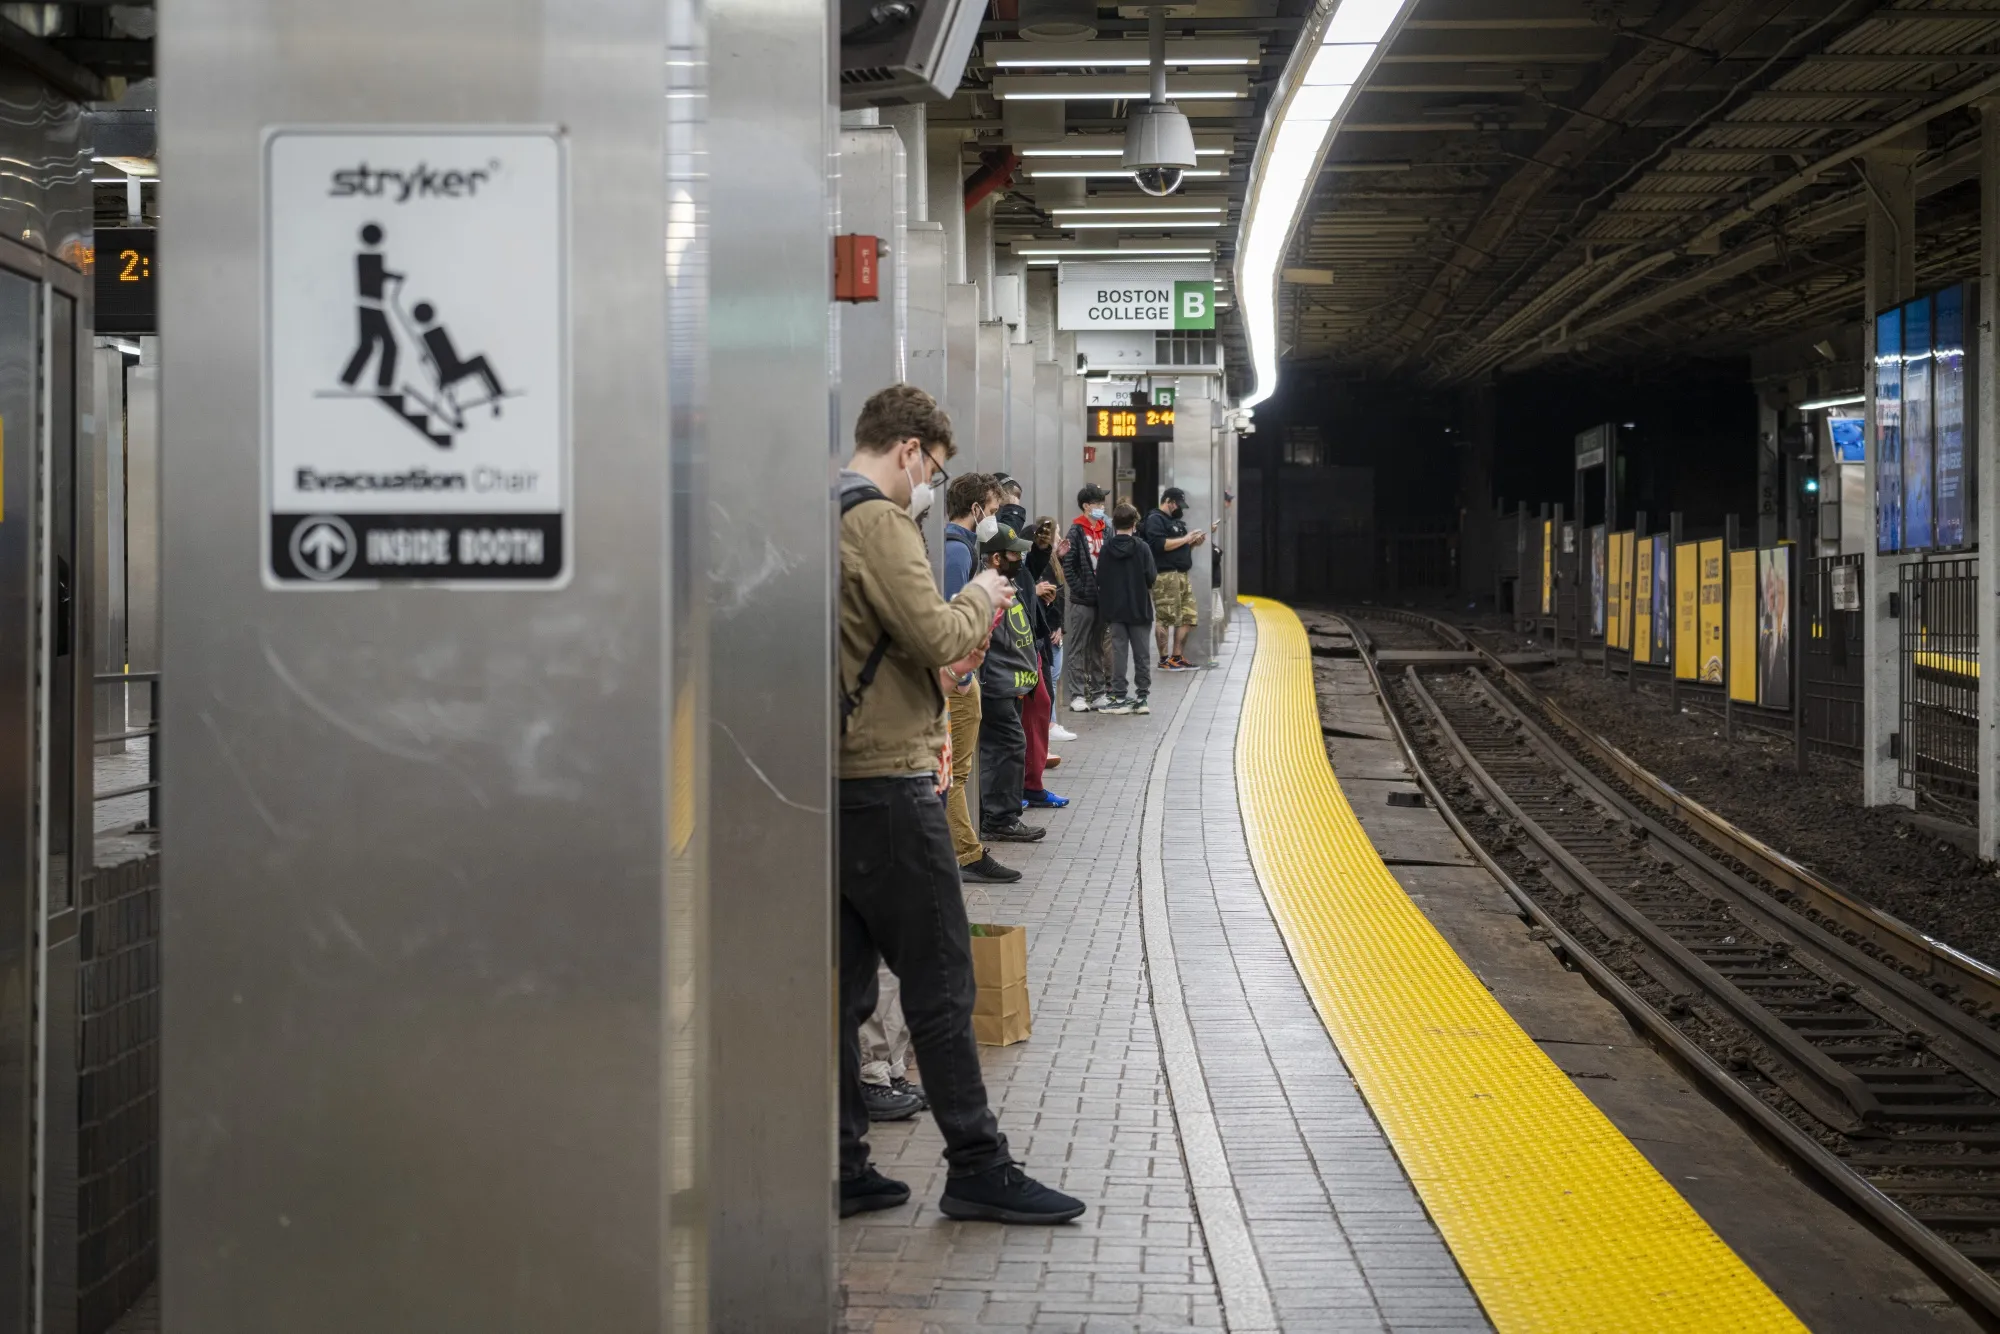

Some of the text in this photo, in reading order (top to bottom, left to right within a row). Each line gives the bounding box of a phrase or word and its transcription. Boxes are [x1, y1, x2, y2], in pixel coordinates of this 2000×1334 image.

[326, 160, 490, 205] stryker
[119, 250, 148, 281] 2:
[1097, 290, 1169, 303] BOSTON
[1183, 292, 1206, 318] B
[1088, 307, 1169, 320] COLLEGE
[1159, 393, 1172, 406] B
[1112, 411, 1136, 425] min
[1112, 425, 1136, 436] min
[295, 466, 540, 494] Evacuation Chair
[366, 529, 544, 565] INSIDE BOOTH
[1011, 604, 1025, 627] T
[1016, 635, 1033, 648] CLEA
